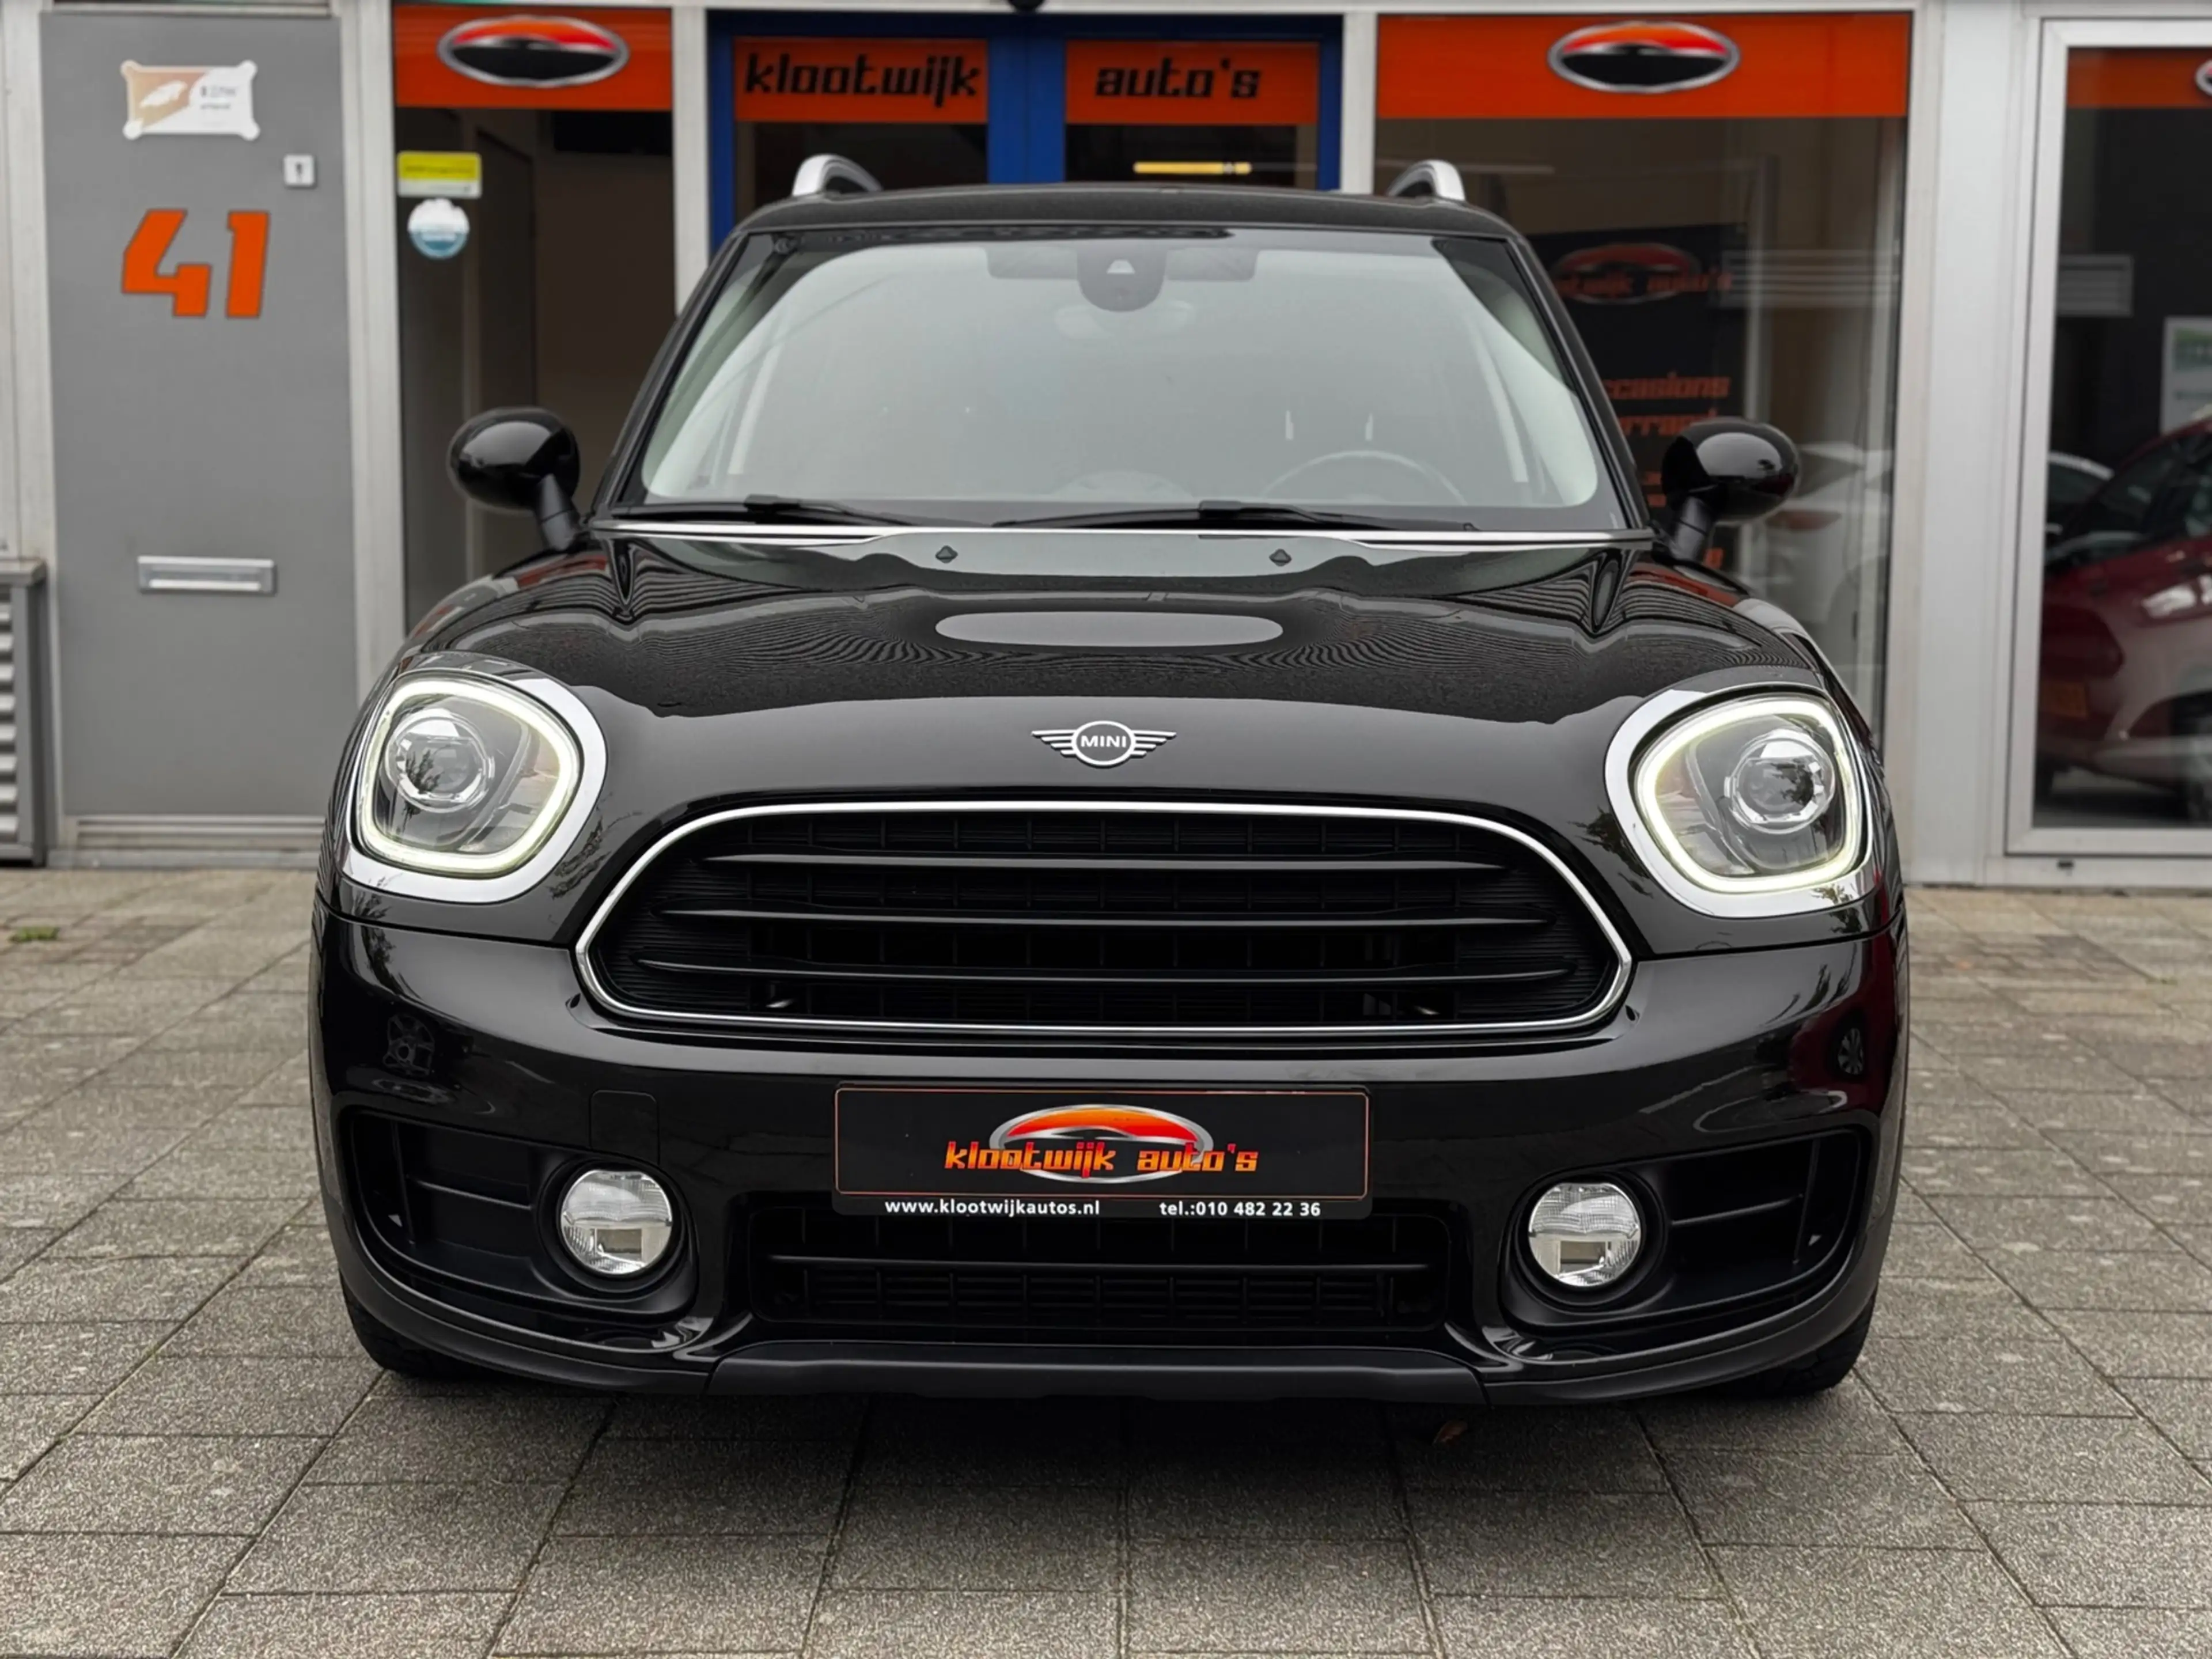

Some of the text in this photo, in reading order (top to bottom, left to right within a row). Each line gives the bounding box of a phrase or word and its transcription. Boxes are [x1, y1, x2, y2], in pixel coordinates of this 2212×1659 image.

[744, 53, 1261, 108] klootwijk auto's
[122, 209, 270, 318] 41
[1080, 734, 1127, 748] MINI
[944, 1141, 1259, 1179] klootwijk auto's
[885, 1198, 1321, 1218] www.klootwijkautos.nl tel.:010 482 22 36
